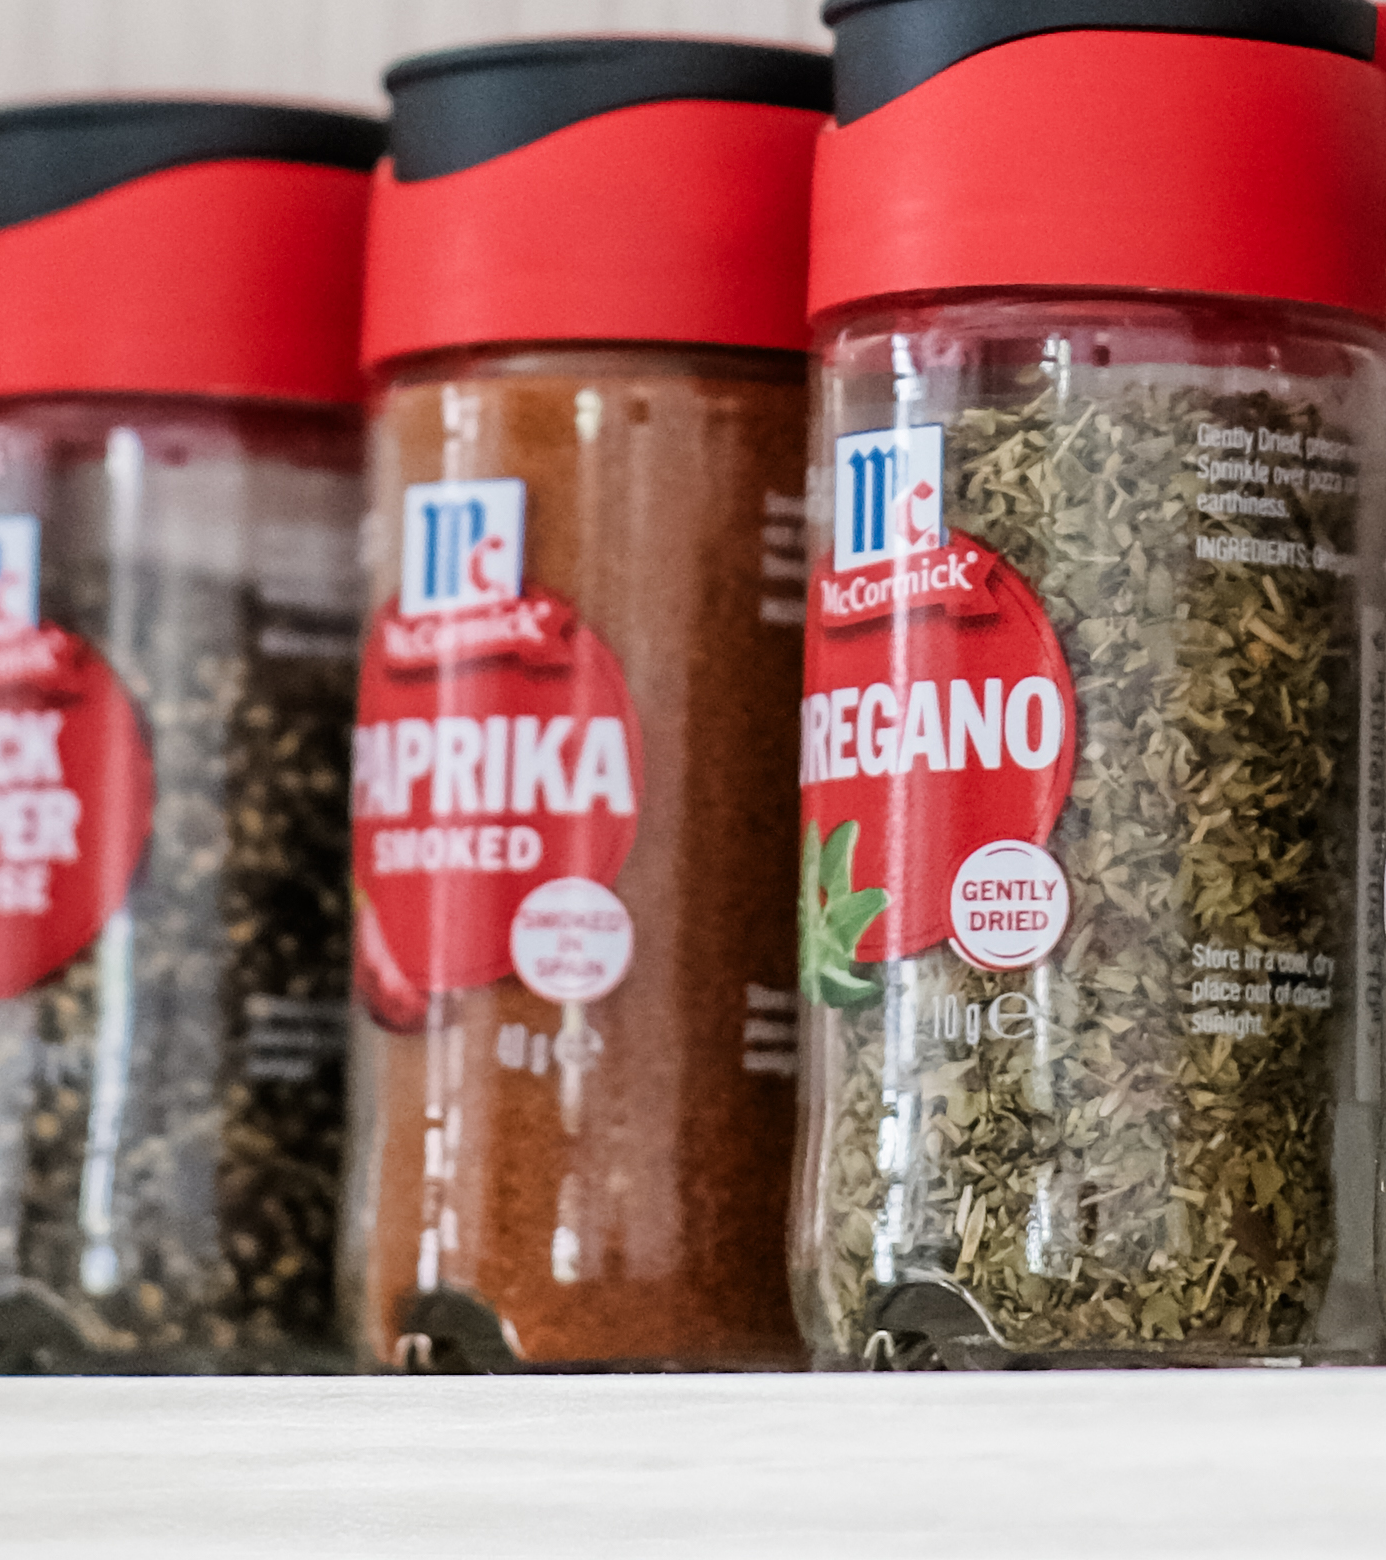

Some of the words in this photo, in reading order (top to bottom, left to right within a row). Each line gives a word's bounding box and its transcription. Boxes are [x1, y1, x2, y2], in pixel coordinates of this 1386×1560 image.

[820, 551, 975, 615] McCormick
[963, 880, 1057, 901] GENTLY
[969, 911, 1049, 931] DRIED
[1191, 943, 1240, 970] Store
[1191, 979, 1241, 1004] place
[933, 994, 958, 1040] 10
